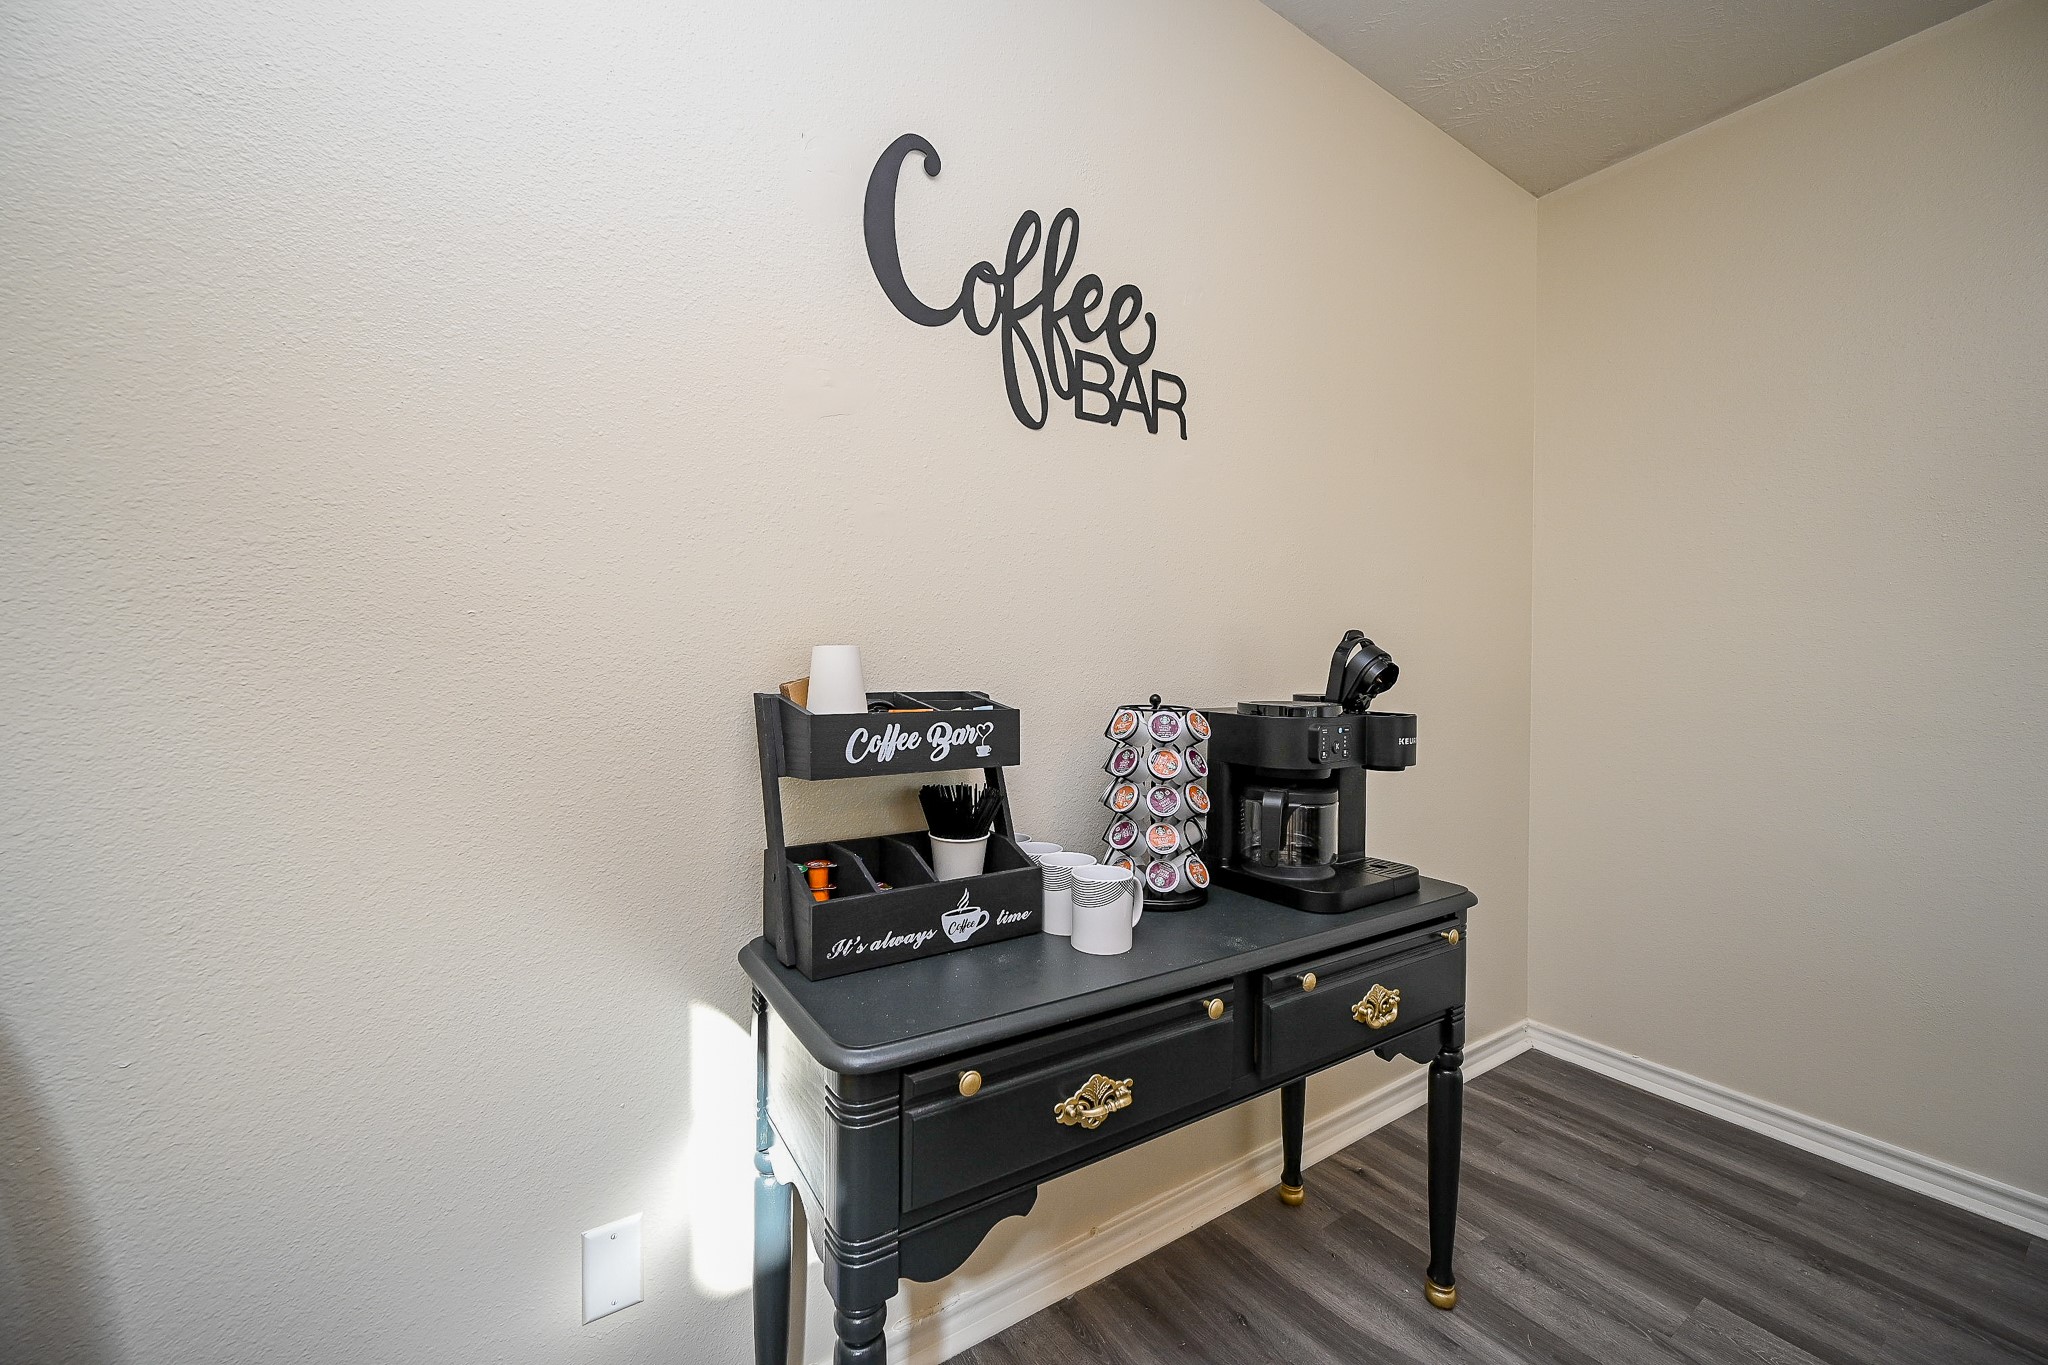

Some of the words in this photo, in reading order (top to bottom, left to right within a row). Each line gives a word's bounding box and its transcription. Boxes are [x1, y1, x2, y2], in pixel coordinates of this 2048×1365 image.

[863, 133, 1157, 430] Coffee
[1074, 349, 1188, 440] BAR
[845, 723, 922, 764] Coffee
[926, 721, 978, 762] Bar
[826, 935, 868, 960] It's
[869, 928, 938, 950] always
[948, 918, 976, 935] Coffee
[996, 909, 1032, 926] time
